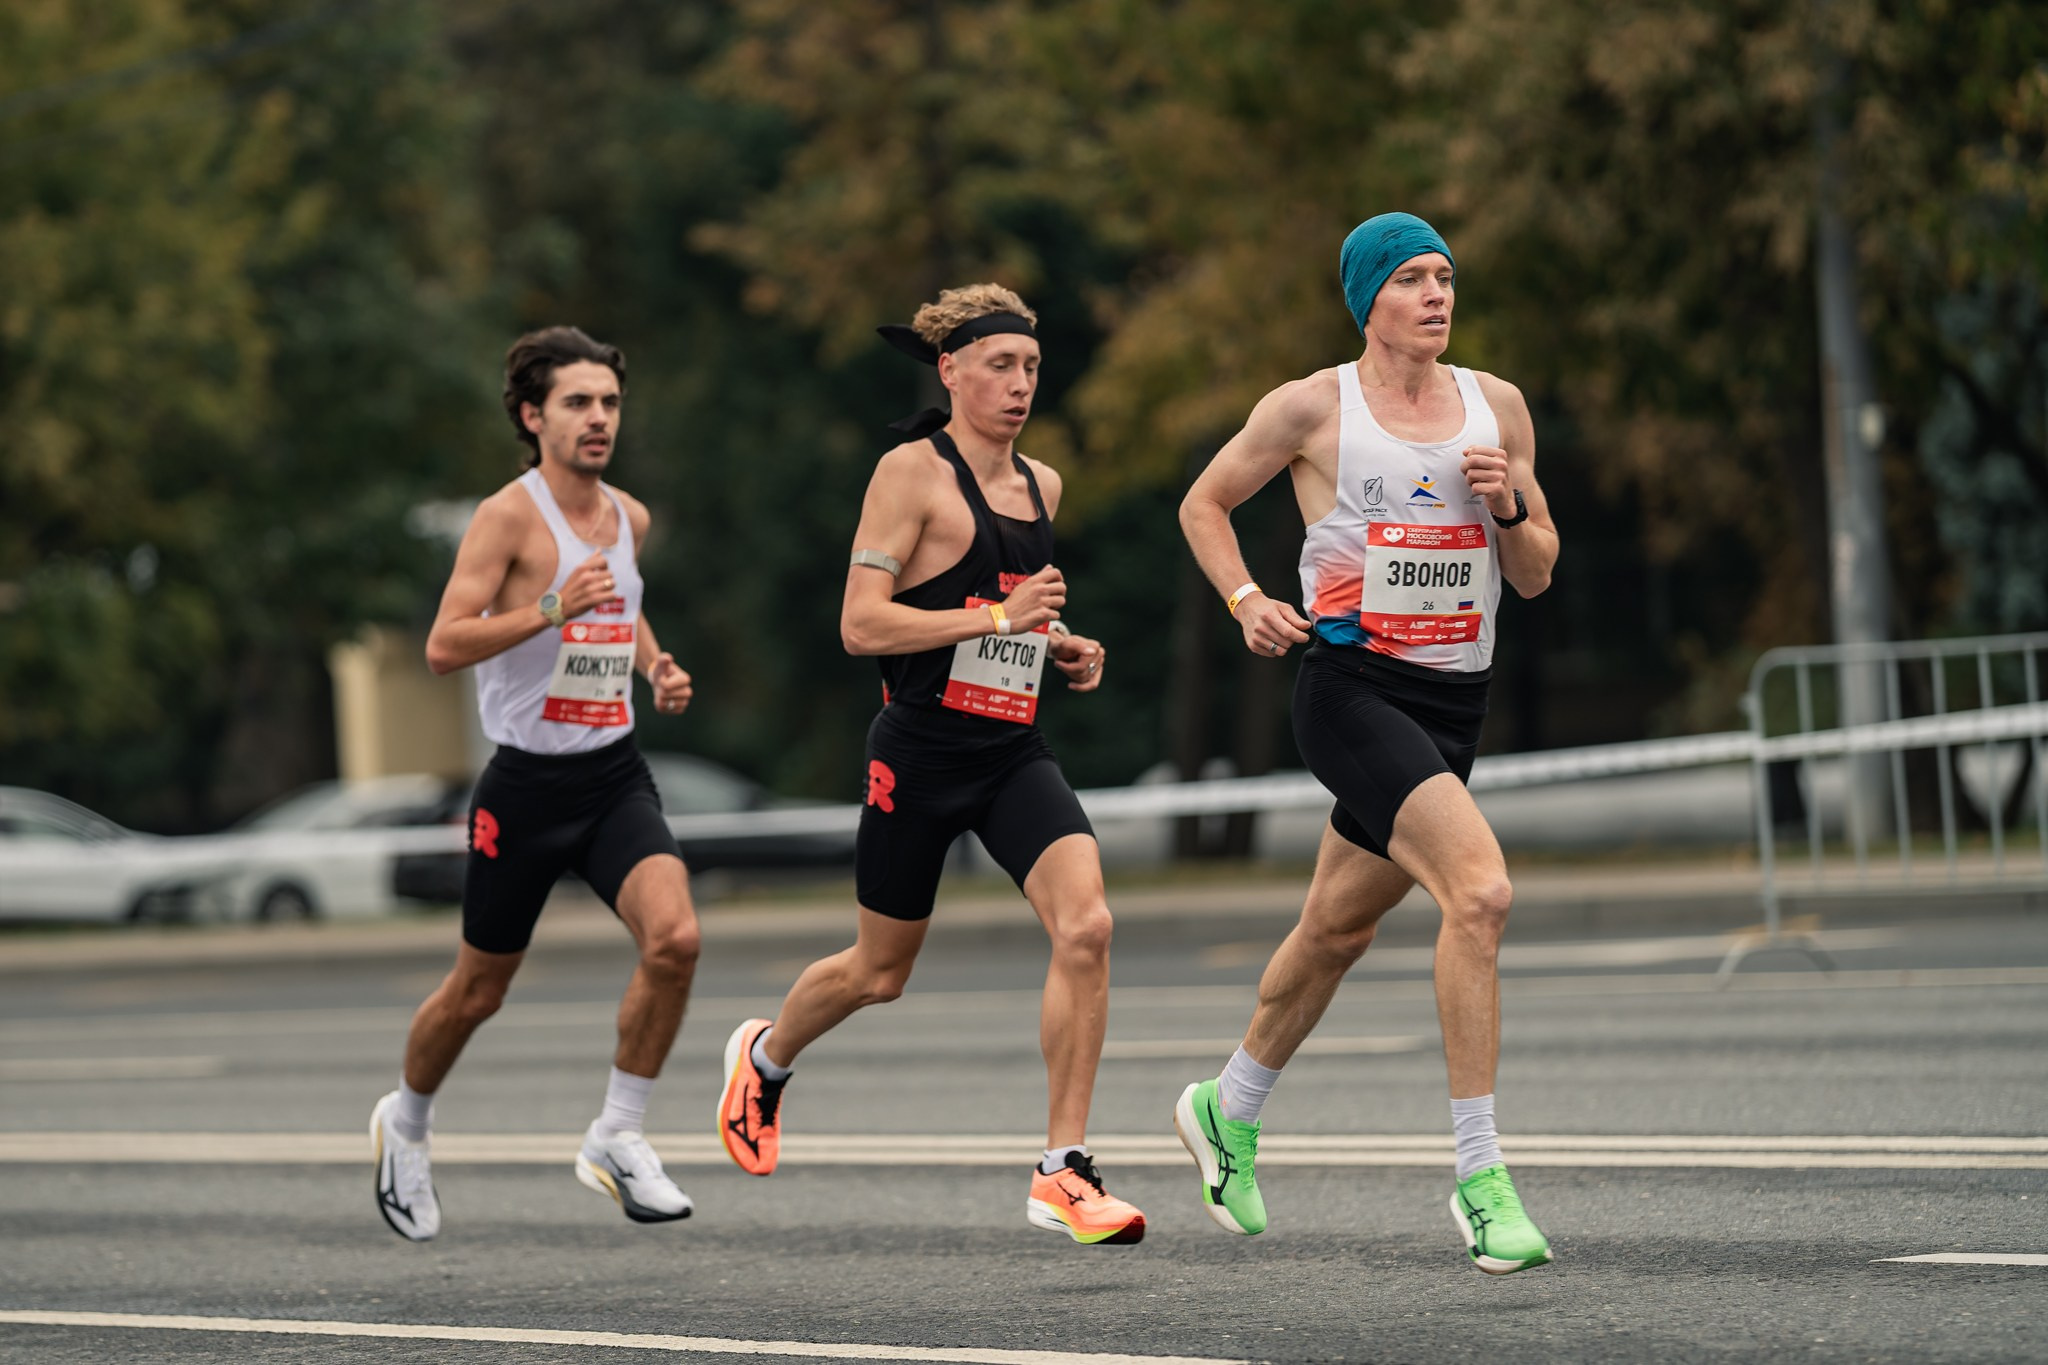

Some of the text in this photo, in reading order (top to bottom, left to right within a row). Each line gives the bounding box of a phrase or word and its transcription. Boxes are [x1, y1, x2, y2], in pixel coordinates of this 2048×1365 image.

[1406, 533, 1453, 541] МОСКОВСКИЙ
[1387, 560, 1472, 587] ЗВОНОВ
[1422, 601, 1434, 611] 26
[977, 636, 1037, 668] КУСТОВ
[1001, 676, 1010, 687] 18
